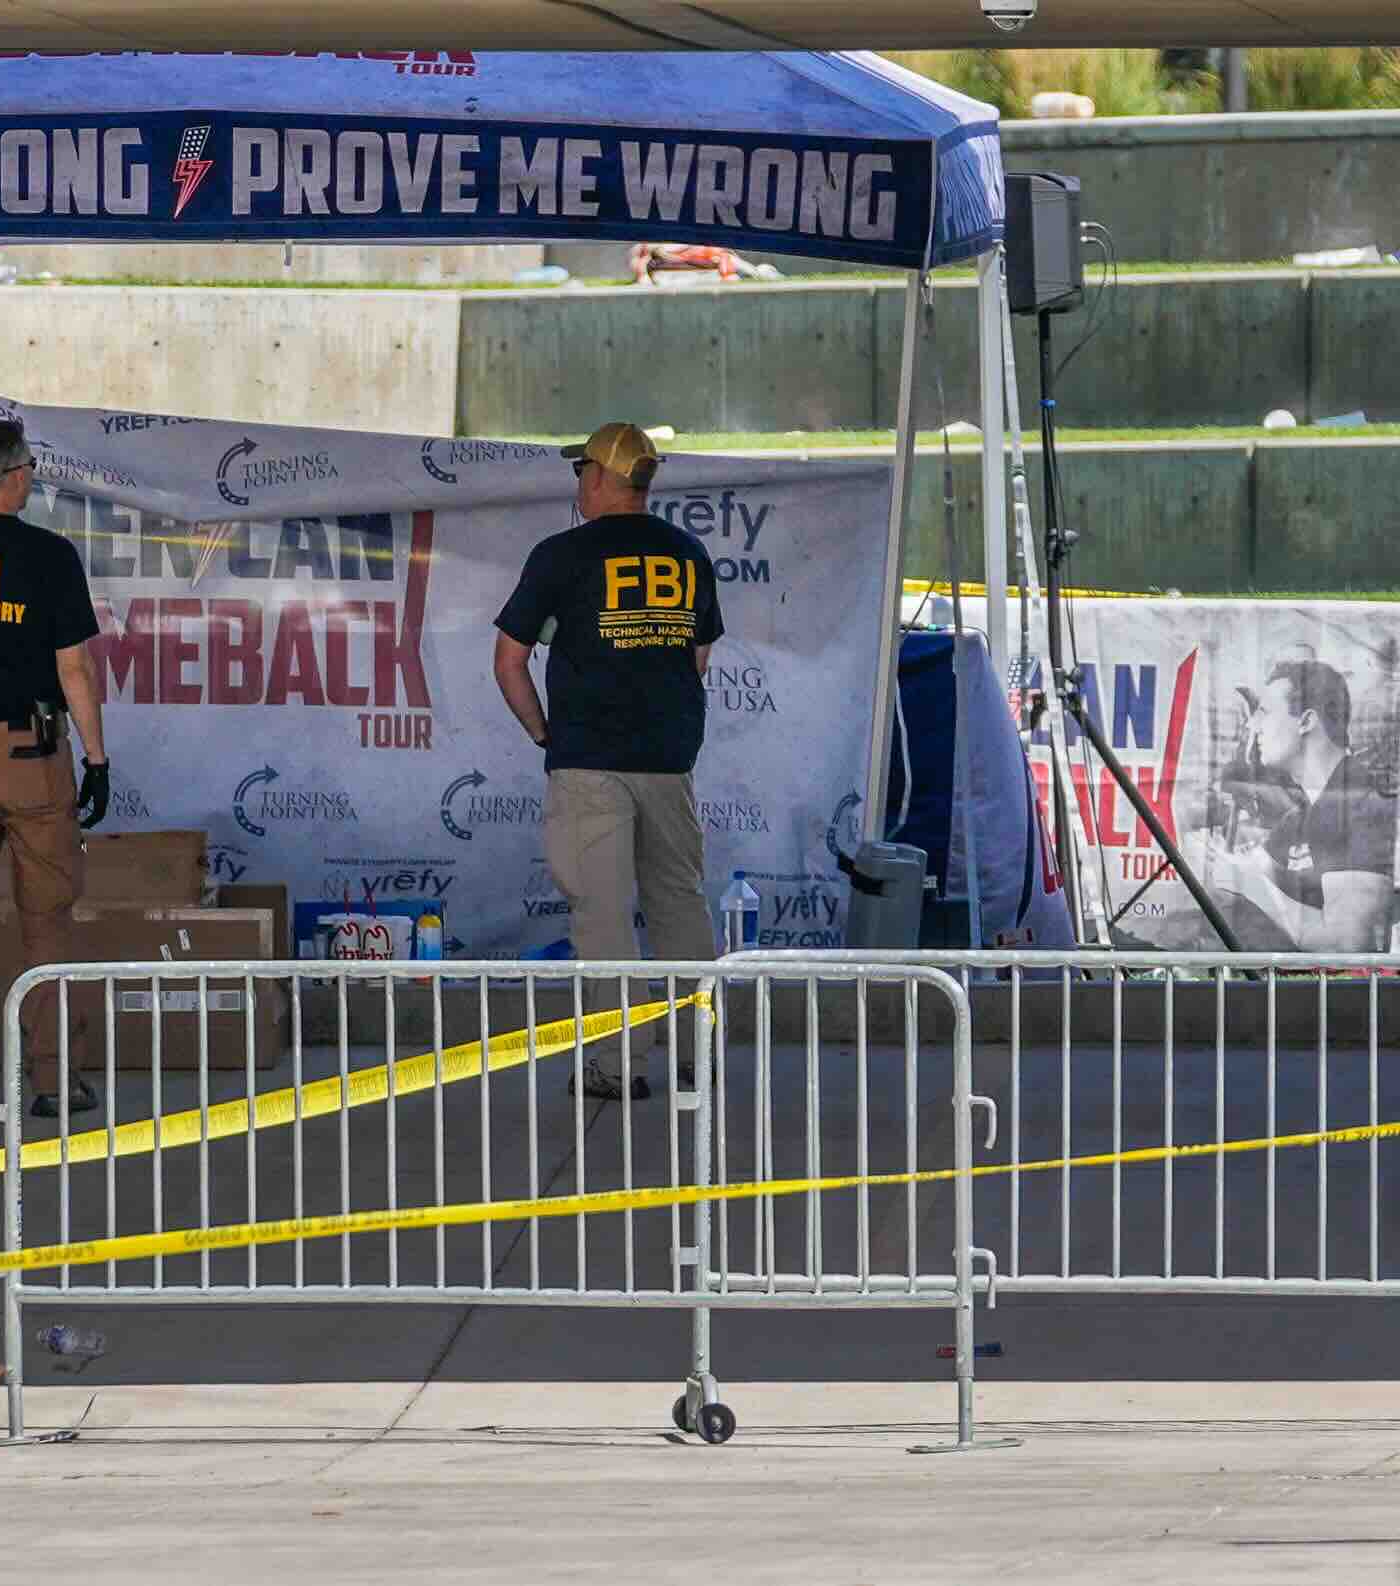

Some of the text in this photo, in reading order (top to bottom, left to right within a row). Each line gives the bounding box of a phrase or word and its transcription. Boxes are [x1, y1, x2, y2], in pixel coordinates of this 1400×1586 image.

[391, 61, 478, 77] TOUR
[232, 127, 481, 215] PROVE
[499, 134, 604, 216] ME
[619, 140, 898, 241] WRONG
[242, 451, 330, 479] TURNING
[449, 447, 549, 466] POINT USA
[38, 464, 137, 489] POINT USA
[243, 465, 339, 489] POINT USA
[604, 556, 696, 610] FBI
[599, 625, 655, 640] TECHNICAL
[613, 636, 688, 649] RESPONSE UNIT
[725, 690, 777, 713] USA
[358, 713, 433, 750] TOUR
[261, 791, 350, 806] TURNING
[467, 795, 544, 810] TURNIN
[115, 804, 151, 817] USA
[260, 806, 360, 822] POINT USA
[467, 808, 526, 825] POINT
[739, 817, 770, 832] USA
